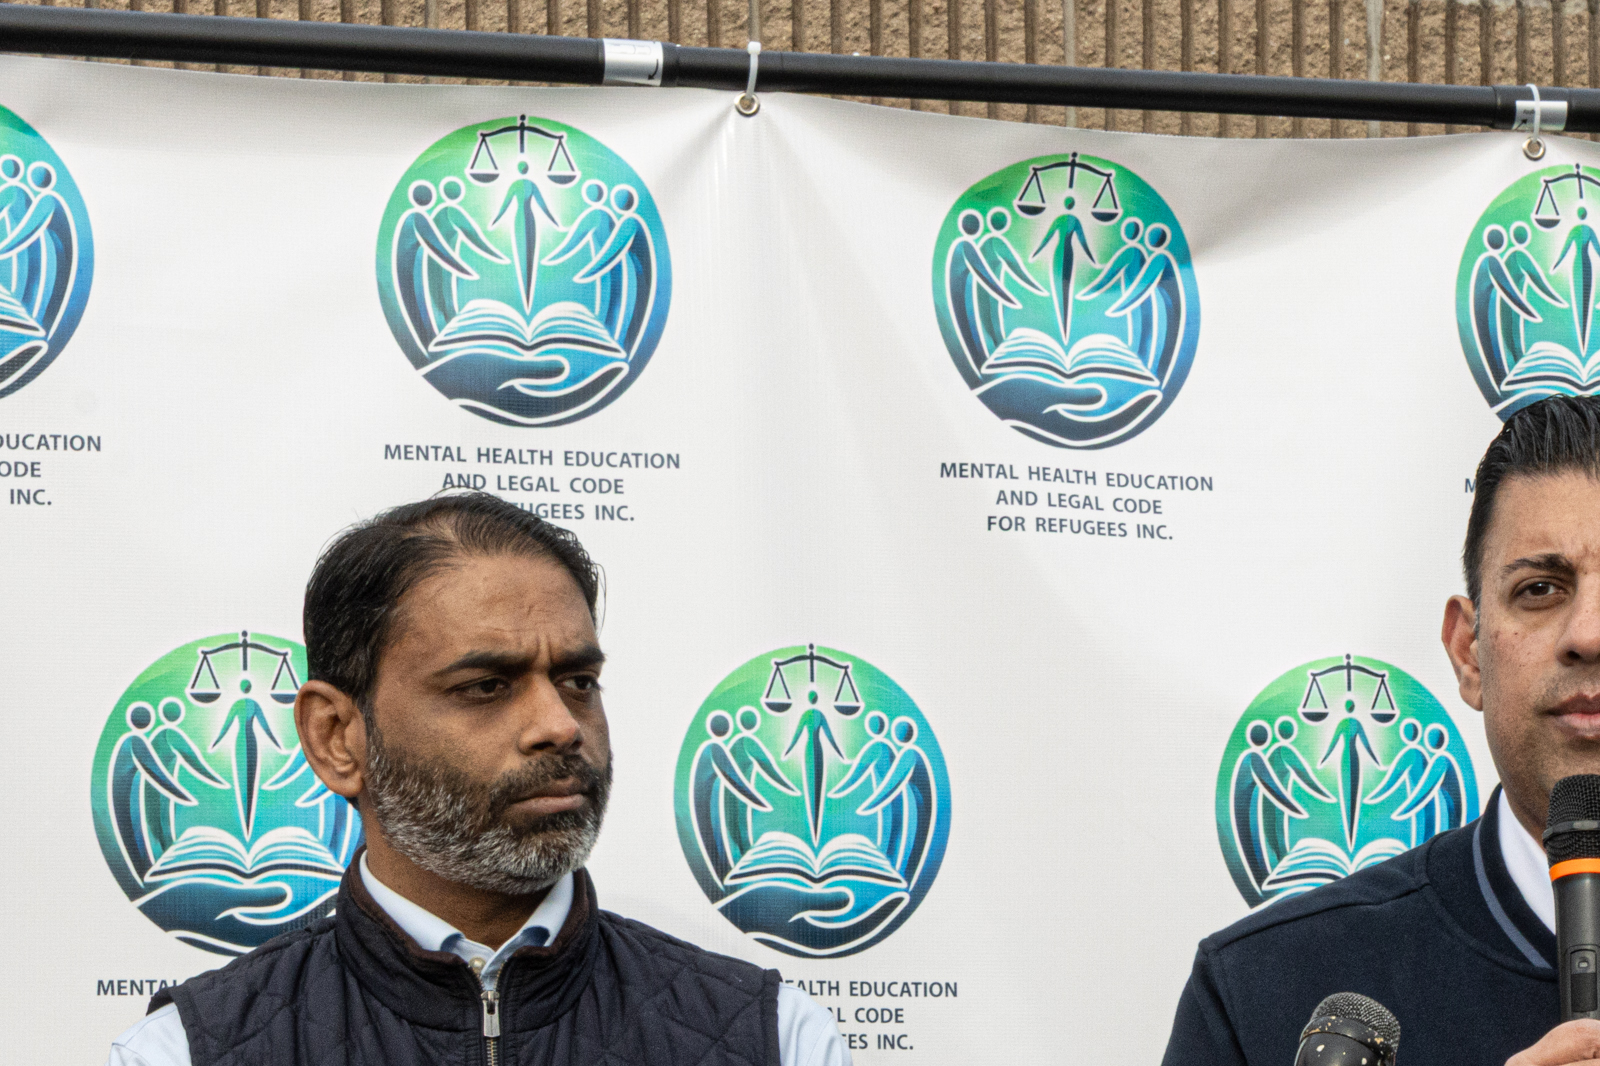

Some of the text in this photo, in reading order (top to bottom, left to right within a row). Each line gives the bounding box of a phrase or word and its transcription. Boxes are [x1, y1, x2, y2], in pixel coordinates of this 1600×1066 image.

[0, 433, 101, 451] UCATION
[385, 445, 679, 468] MENTAL HEALTH EDUCATION
[0, 461, 41, 477] ODE
[941, 463, 1212, 491] MENTAL HEALTH EDUCATION
[442, 472, 624, 494] AND LEGAL CODE
[11, 489, 51, 505] INC.
[996, 490, 1162, 514] AND LEGAL CODE
[513, 502, 634, 521] GEES INC.
[988, 516, 1172, 539] FOR REFUGEES INC.
[784, 980, 957, 997] ALTH EDUCATION
[855, 1008, 904, 1023] CODE
[878, 1034, 913, 1049] INC.
